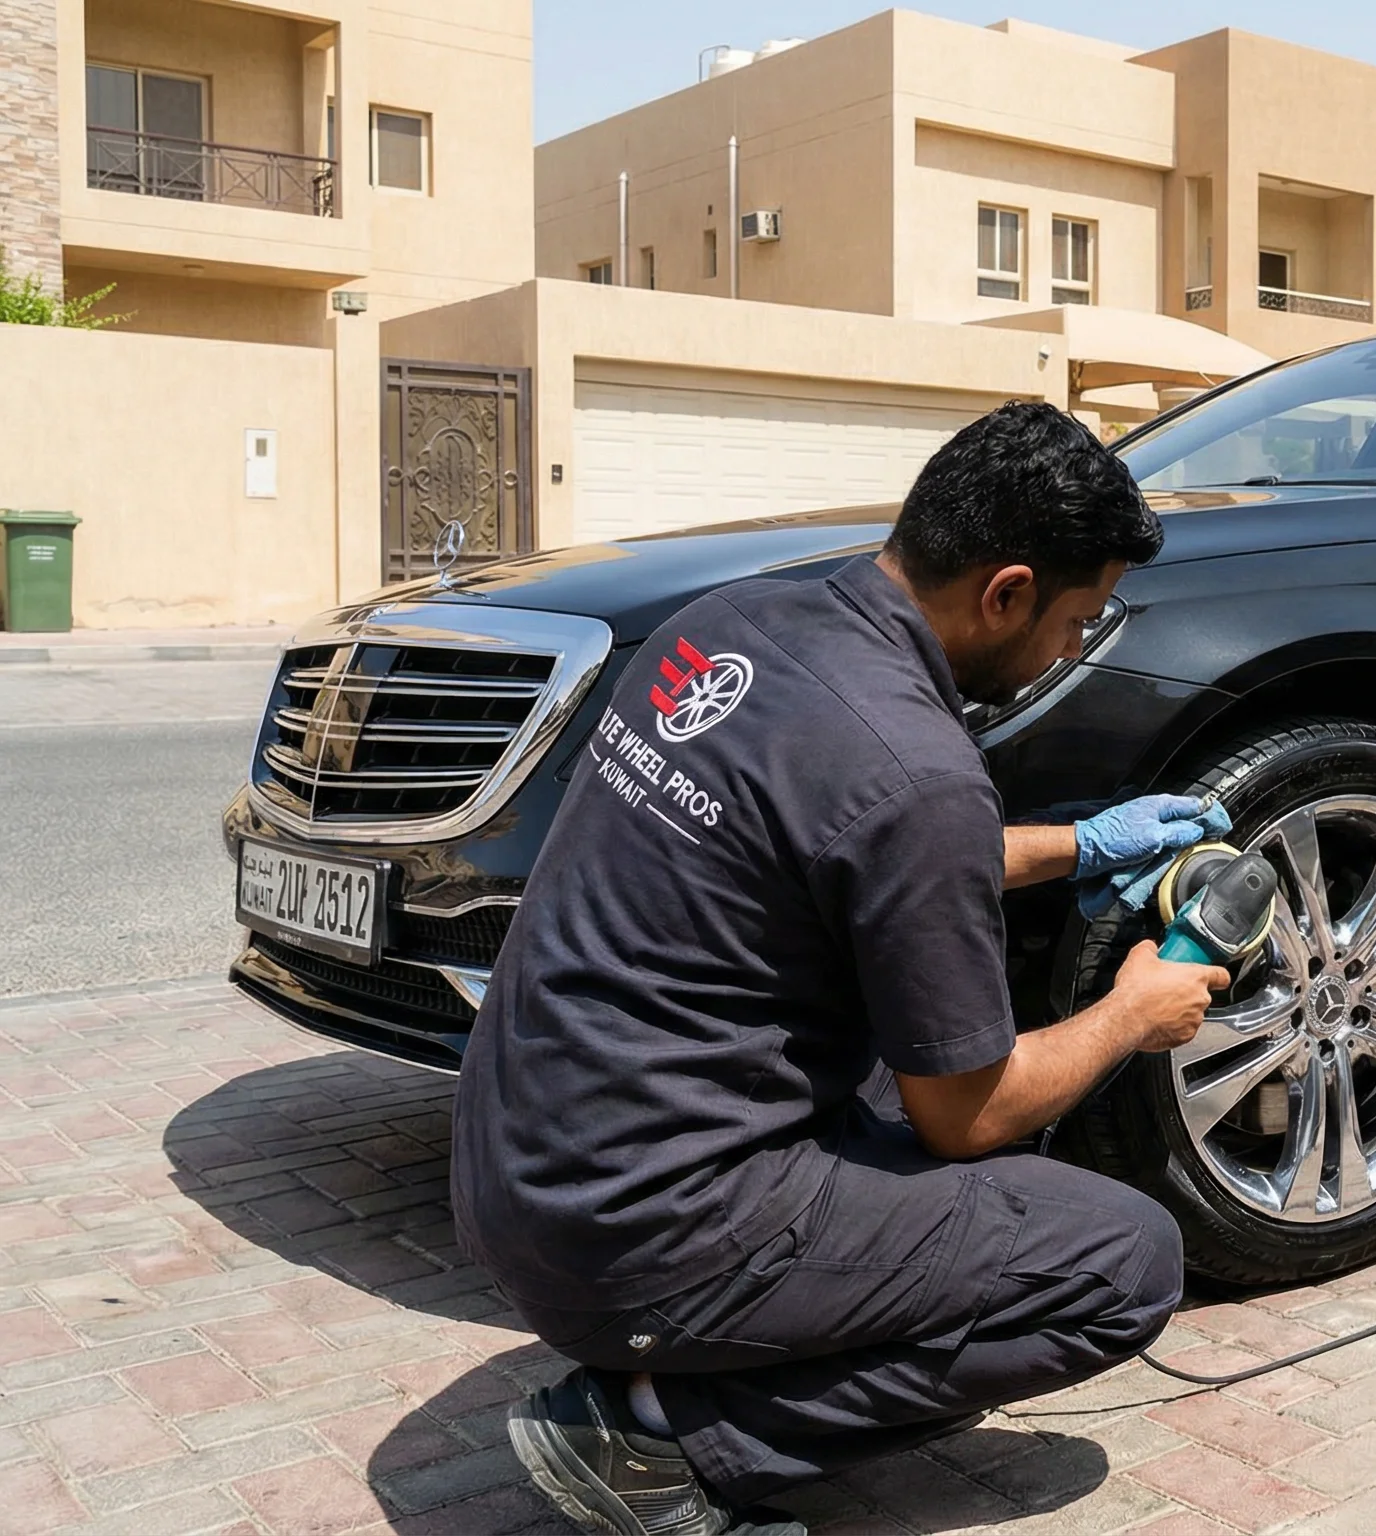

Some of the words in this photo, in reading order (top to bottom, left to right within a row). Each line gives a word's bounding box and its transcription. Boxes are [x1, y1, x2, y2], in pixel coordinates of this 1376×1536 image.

[598, 757, 647, 808] KUWAIT
[616, 728, 667, 786] WHEEL
[662, 770, 722, 826] PROS
[314, 868, 369, 940] 2512
